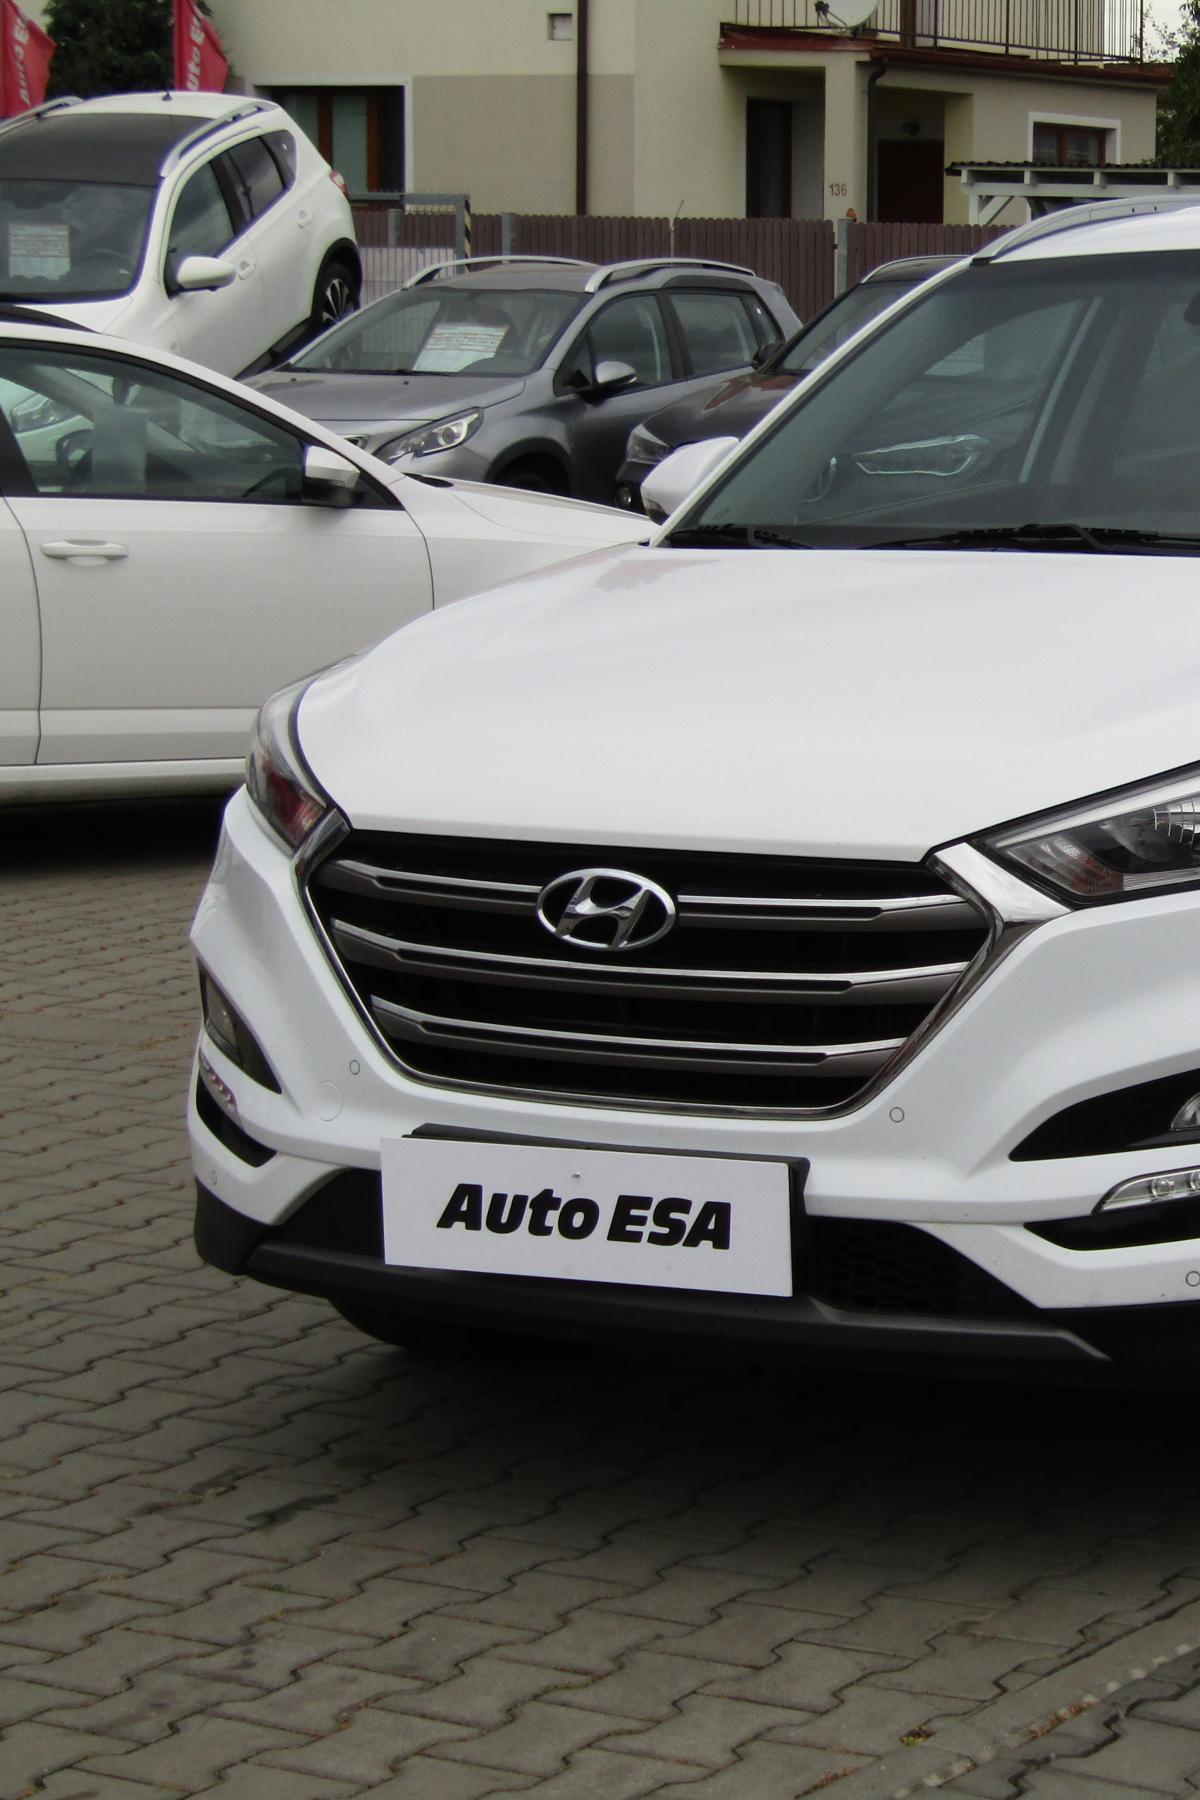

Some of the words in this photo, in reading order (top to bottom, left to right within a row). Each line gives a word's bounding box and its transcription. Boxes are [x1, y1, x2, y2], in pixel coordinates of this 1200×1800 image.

[186, 47, 201, 92] uto
[829, 183, 848, 197] 136
[436, 1183, 600, 1240] Auto
[606, 1194, 732, 1250] ESA
